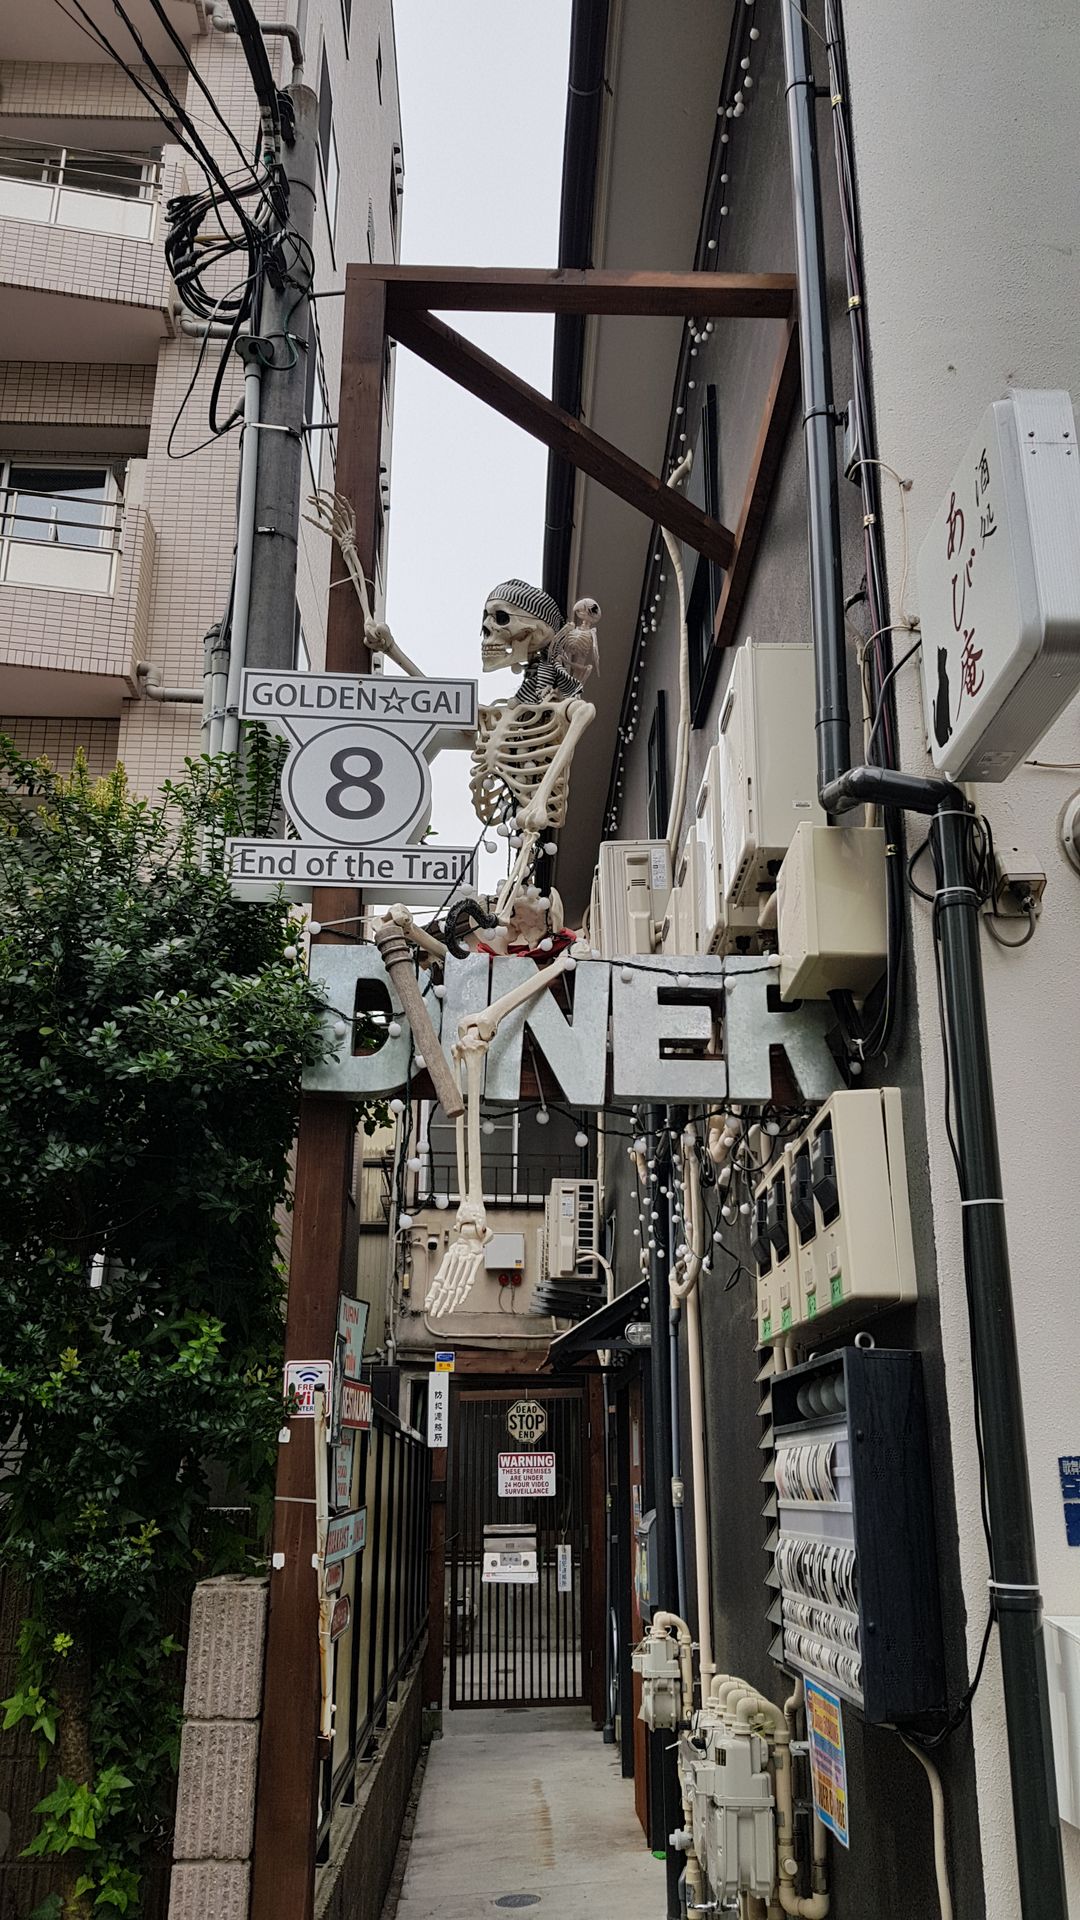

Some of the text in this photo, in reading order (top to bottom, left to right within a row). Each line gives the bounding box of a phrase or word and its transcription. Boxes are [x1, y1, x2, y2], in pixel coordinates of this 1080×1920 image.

[974, 448, 998, 549] 酒処
[945, 491, 985, 721] あび庵
[325, 746, 385, 820] 8
[241, 848, 466, 880] End of the Trail
[300, 943, 848, 1108] DINER
[297, 1383, 315, 1391] FRE
[516, 1405, 537, 1414] DEAD
[509, 1414, 544, 1430] STOP
[518, 1430, 535, 1439] END
[500, 1455, 553, 1468] WARNING
